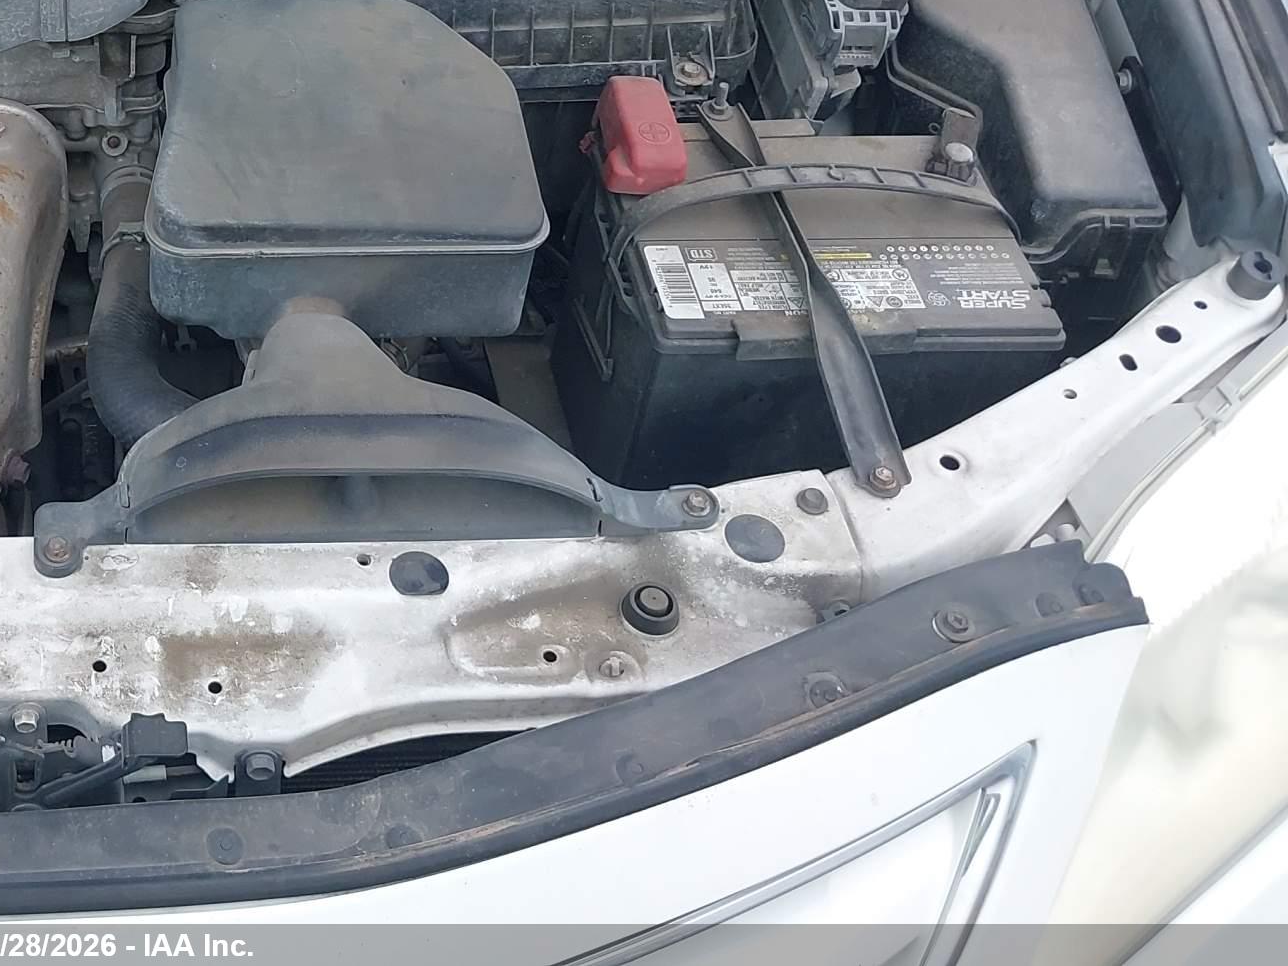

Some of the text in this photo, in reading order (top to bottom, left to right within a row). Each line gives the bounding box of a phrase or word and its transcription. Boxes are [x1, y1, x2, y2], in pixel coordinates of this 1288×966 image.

[690, 249, 713, 259] STD
[956, 289, 1031, 301] START
[959, 299, 1027, 310] SUPER
